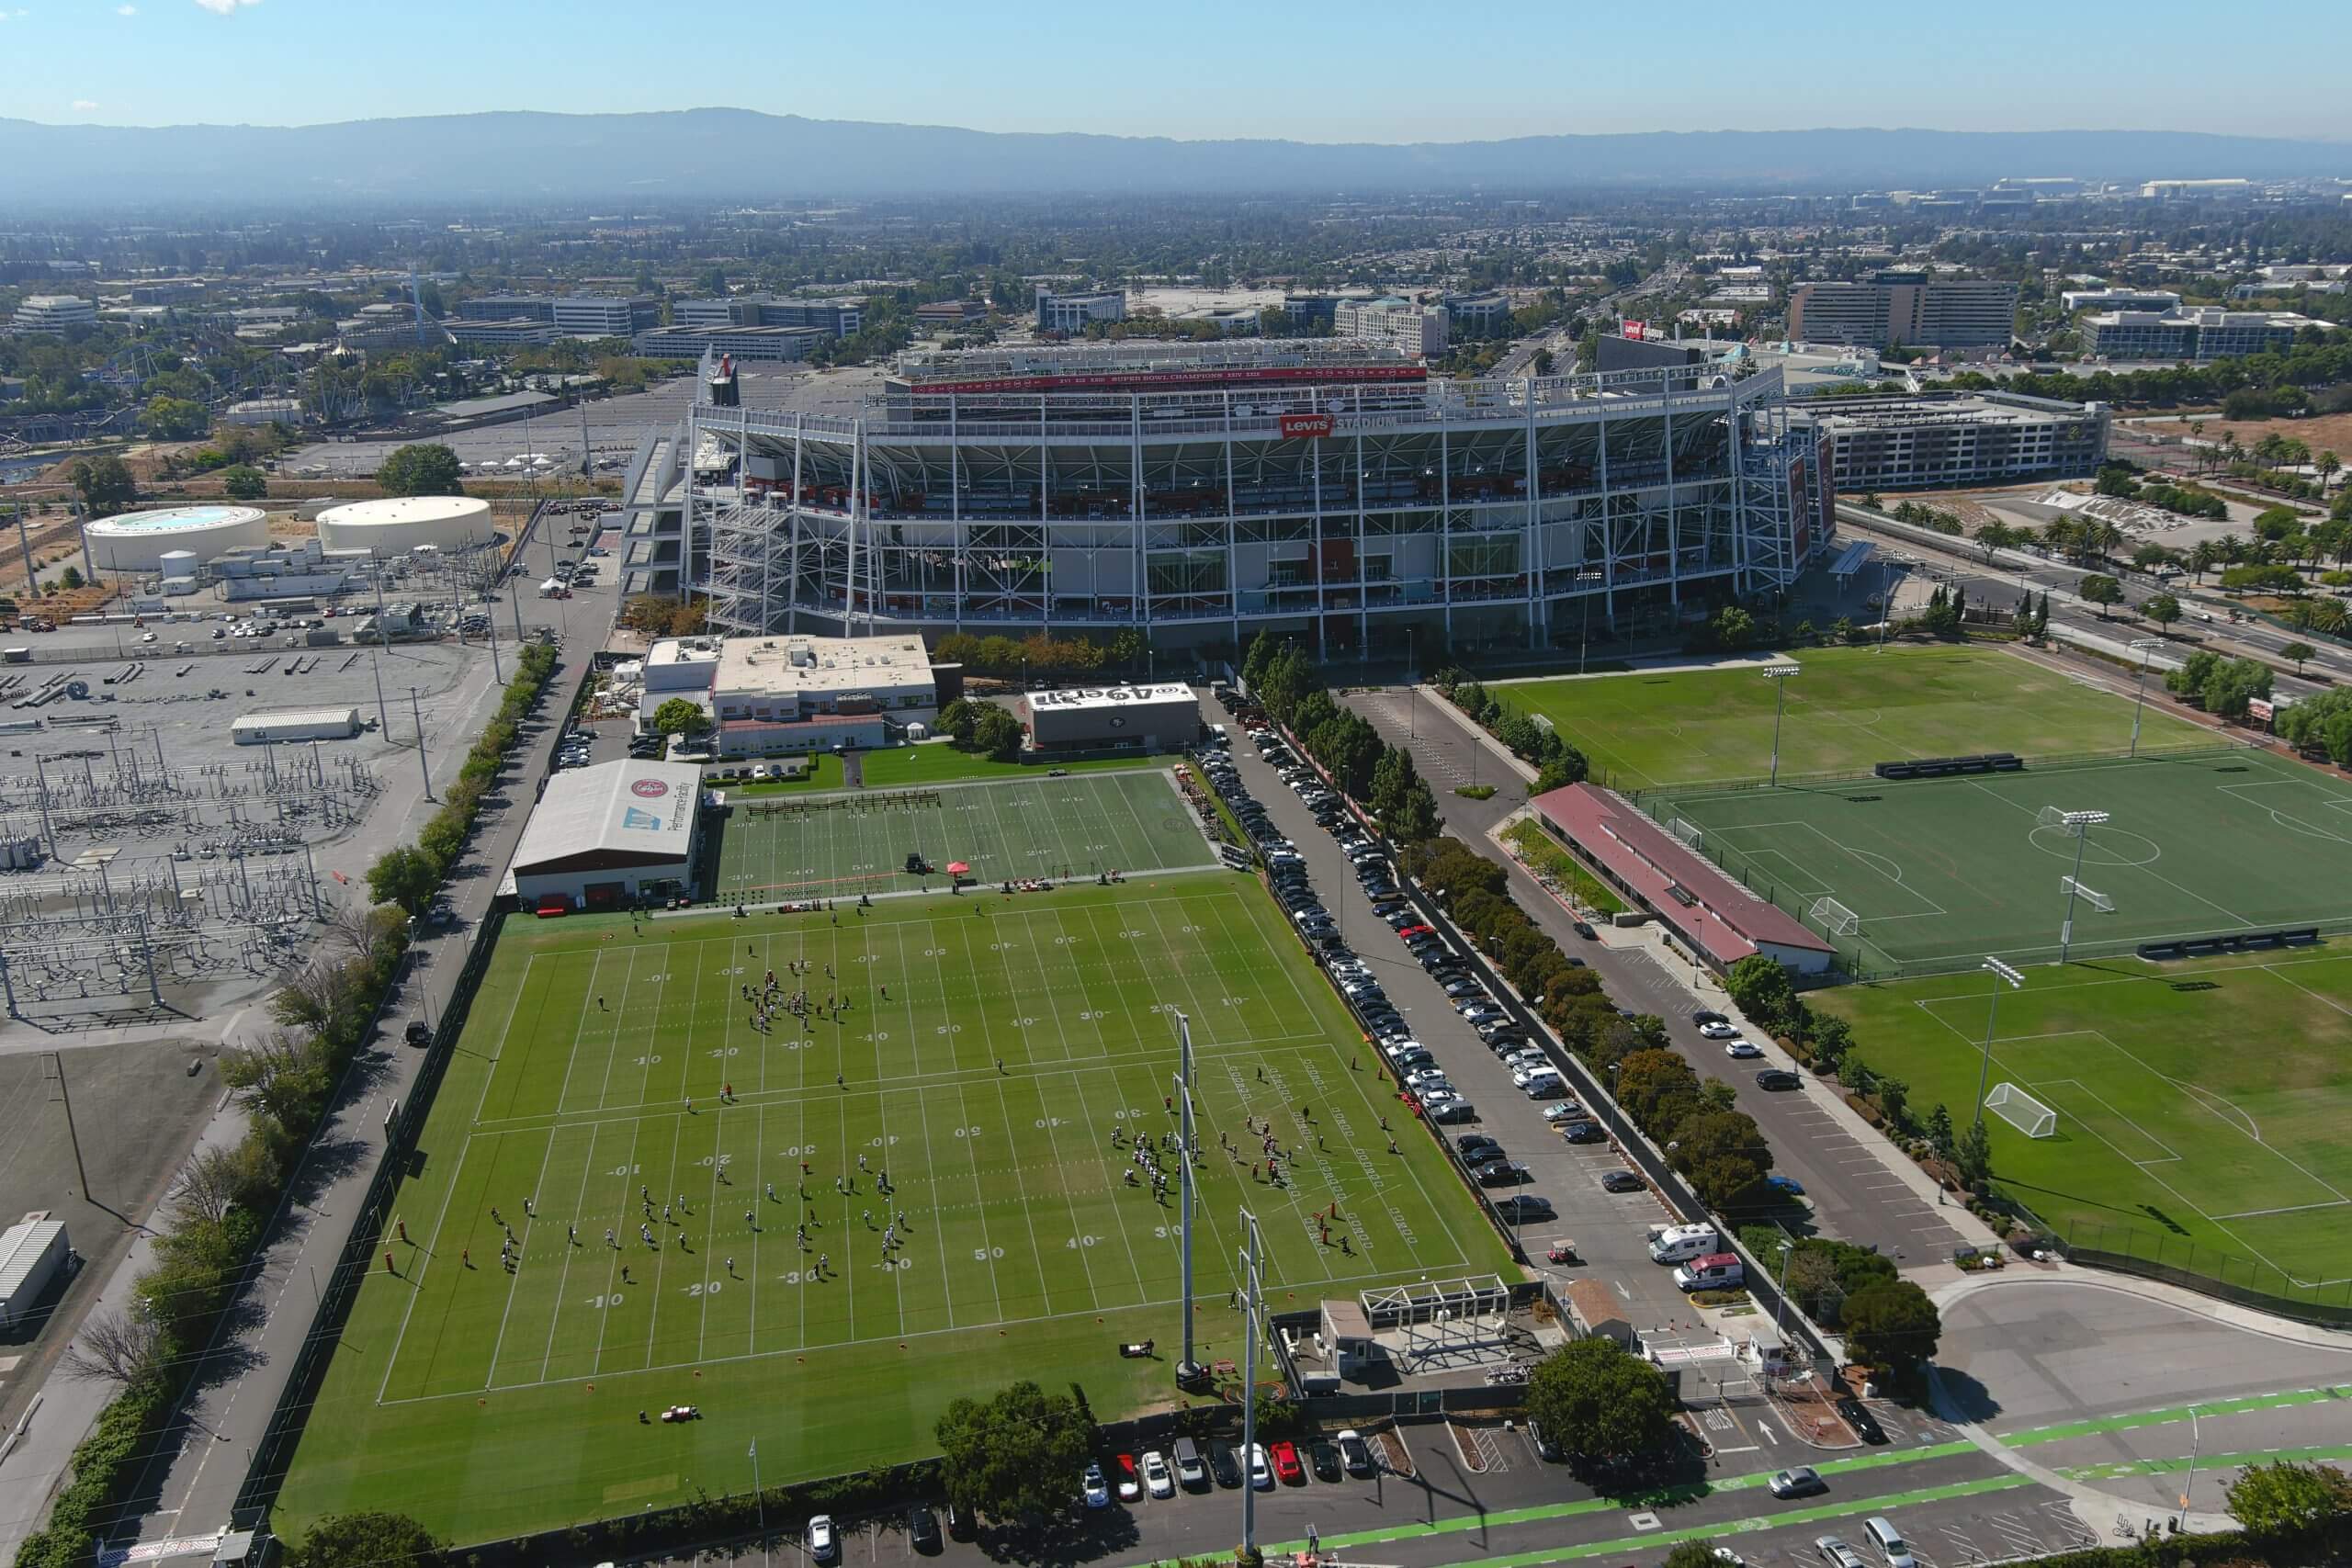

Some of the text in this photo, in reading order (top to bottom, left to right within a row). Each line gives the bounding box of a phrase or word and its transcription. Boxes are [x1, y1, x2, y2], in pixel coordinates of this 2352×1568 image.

[1170, 372, 1223, 380] CHAMPIONS
[1337, 416, 1396, 429] STADIUM
[974, 1247, 1004, 1261] 50
[689, 1280, 722, 1297] 20
[1702, 1408, 1735, 1431] STOP
